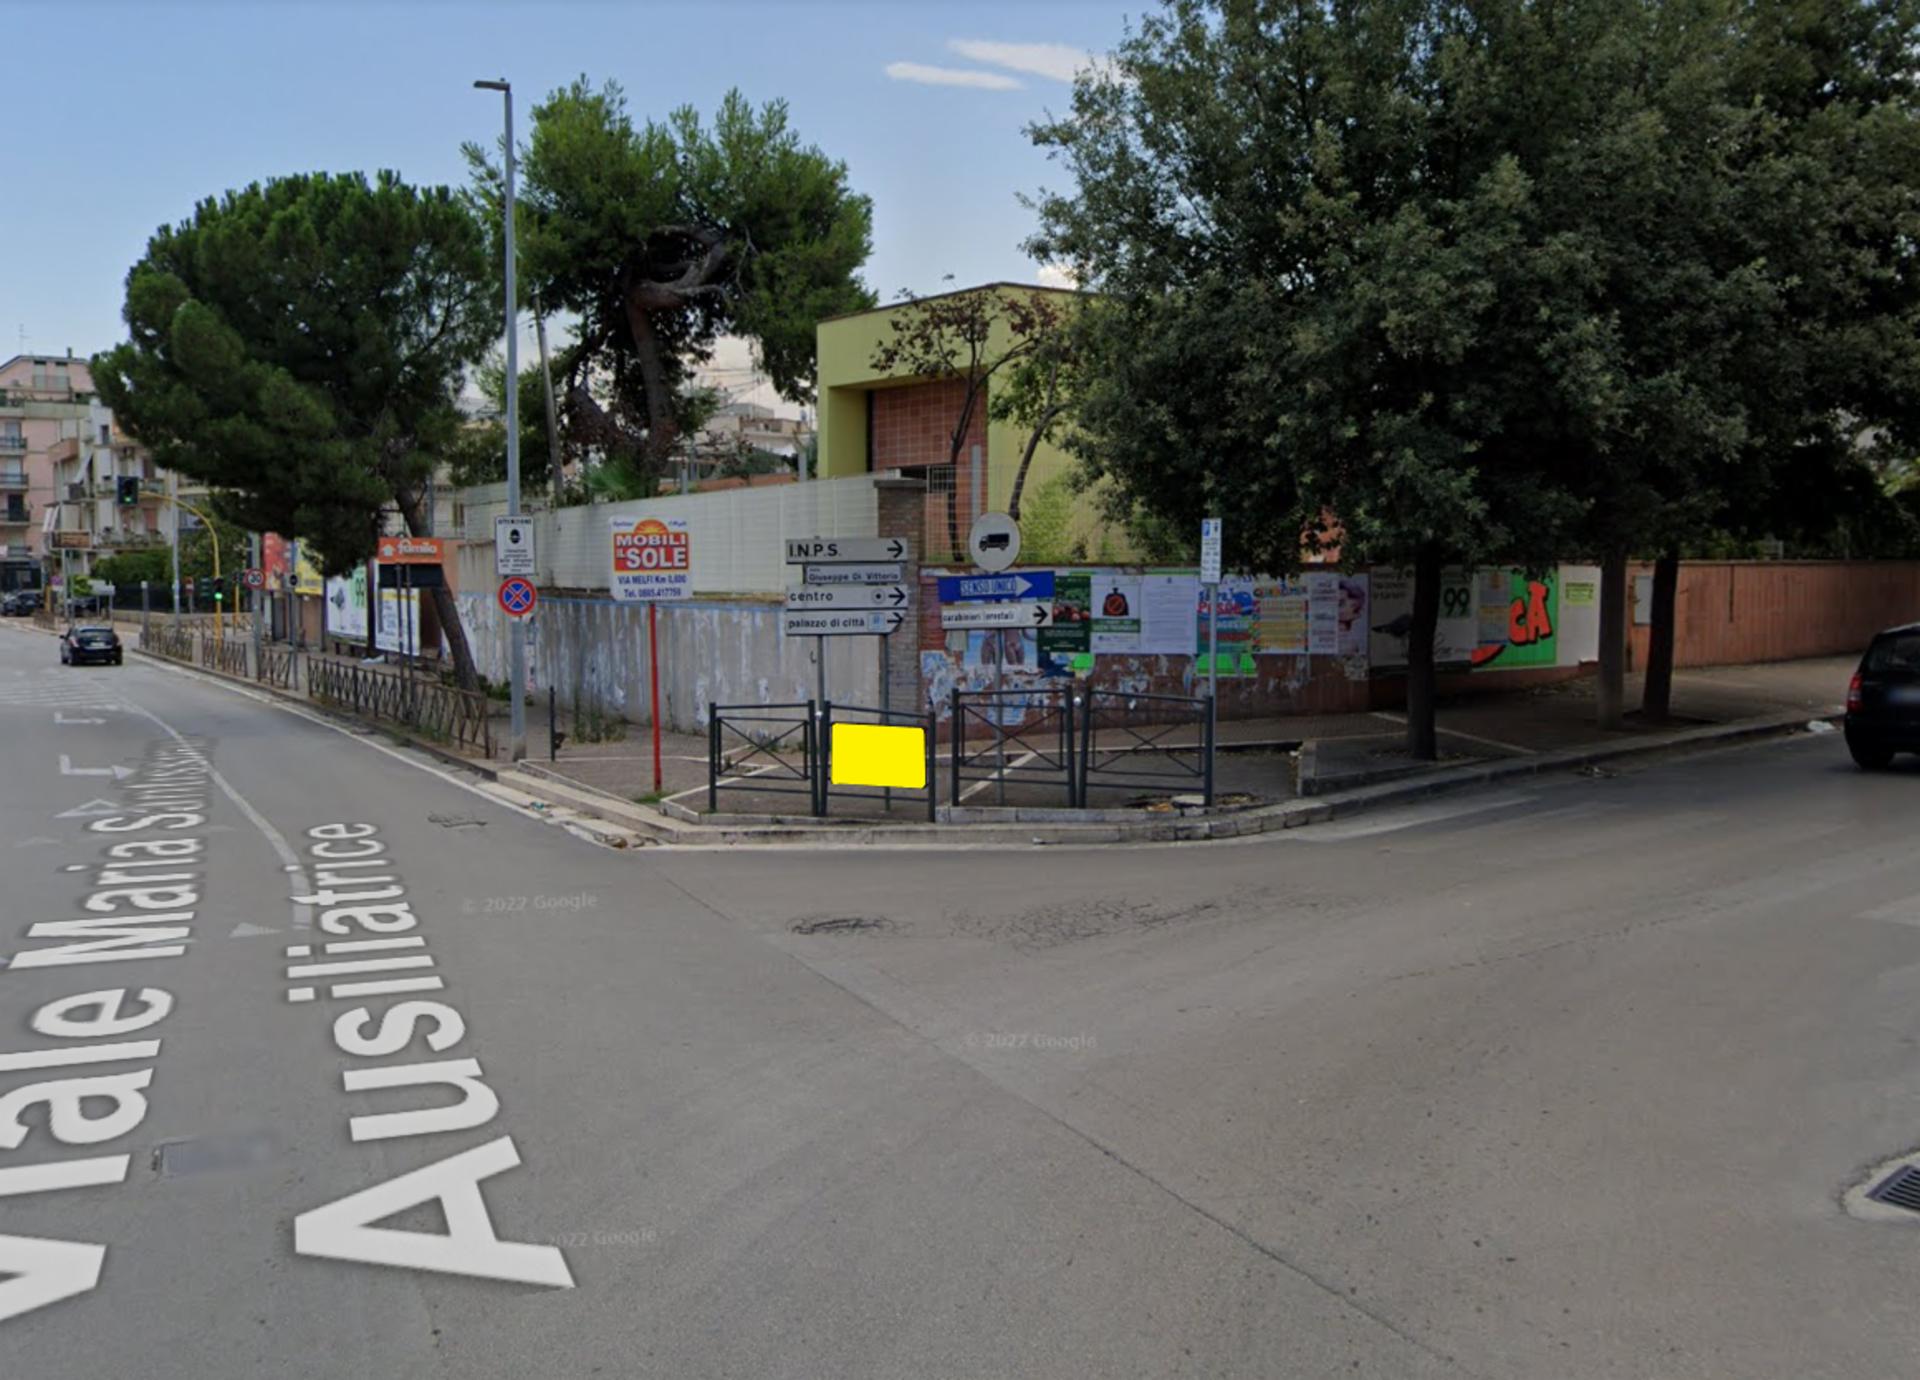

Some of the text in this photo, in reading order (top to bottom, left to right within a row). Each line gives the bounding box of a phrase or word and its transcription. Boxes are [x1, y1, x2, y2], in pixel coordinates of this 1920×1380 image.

[616, 534, 686, 546] MOBILI
[789, 543, 842, 557] I.N.P.S.
[626, 547, 687, 568] SOLE
[808, 573, 849, 582] Giuseppe
[865, 571, 899, 580] Vittorio
[960, 578, 1017, 595] SENSO UNICO
[790, 592, 834, 602] centro
[1444, 587, 1470, 618] 99
[788, 617, 865, 629] palazzo di città
